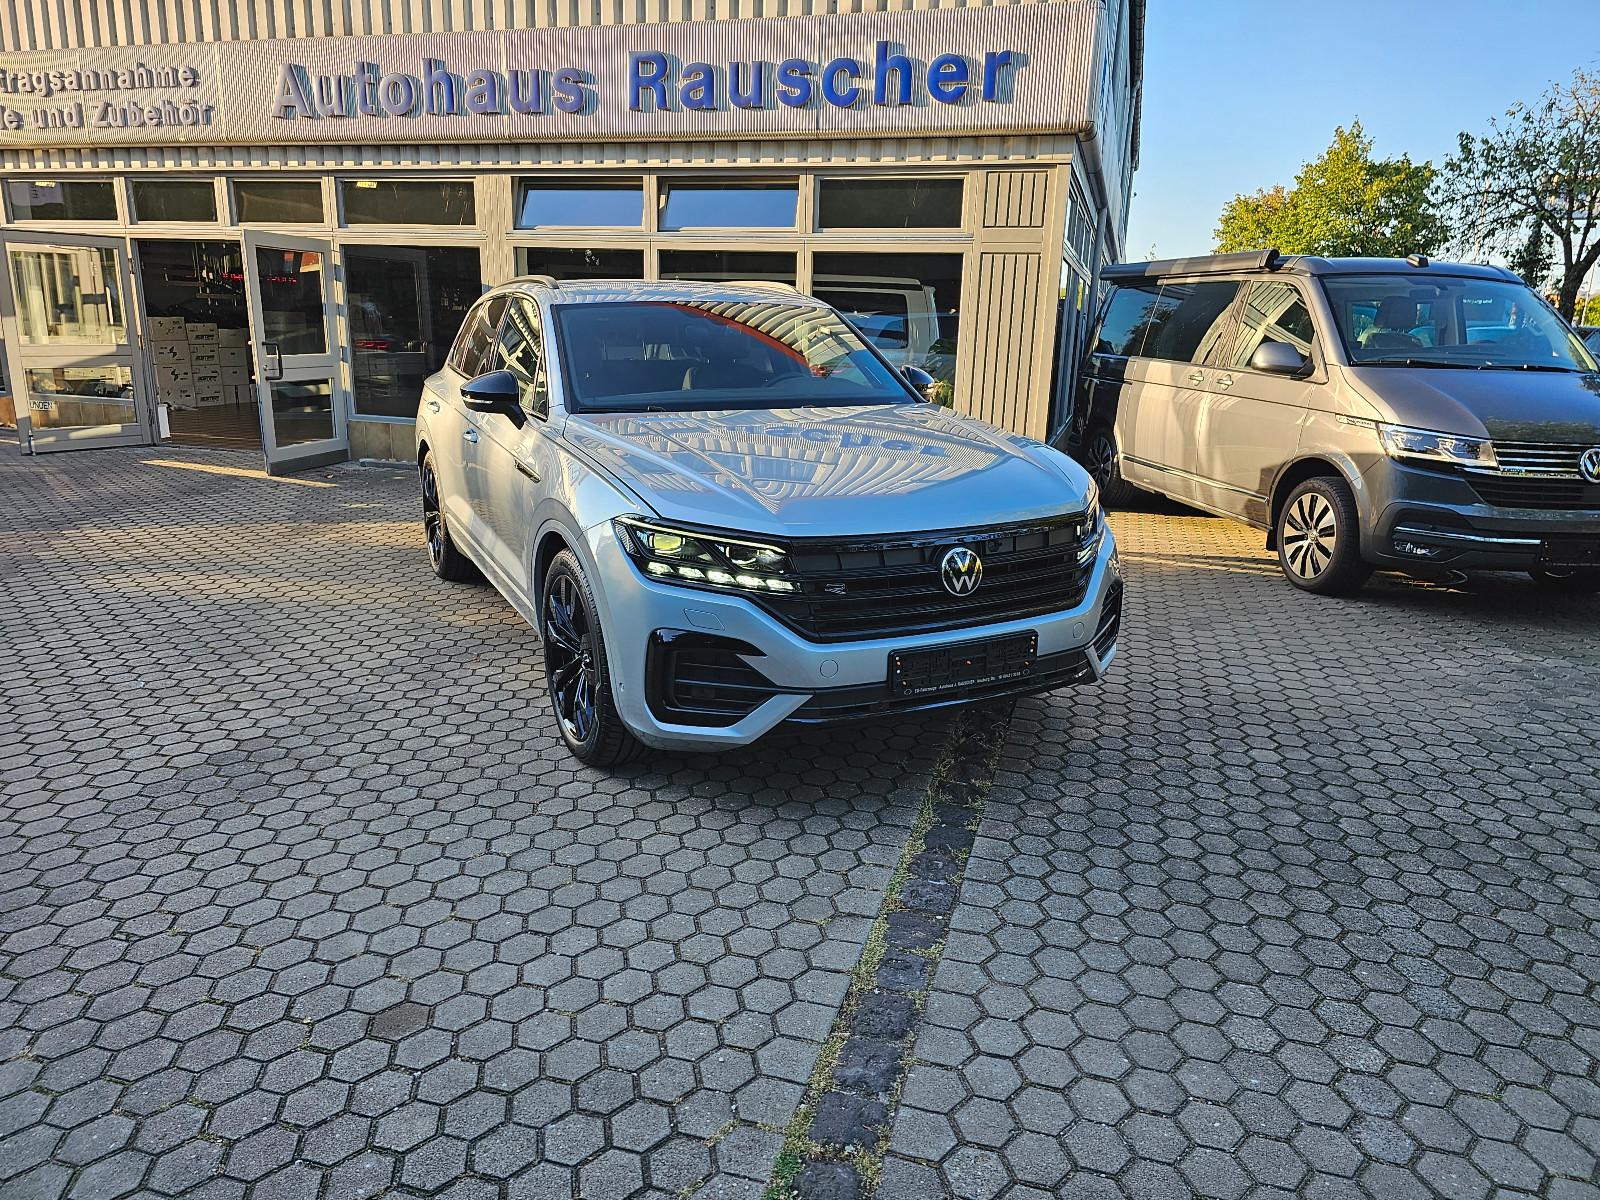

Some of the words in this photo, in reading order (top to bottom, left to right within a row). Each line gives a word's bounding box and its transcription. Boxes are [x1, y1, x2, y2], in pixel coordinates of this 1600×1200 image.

[272, 57, 585, 119] Autohaus
[628, 40, 1012, 111] Rauscher
[0, 105, 19, 129] e
[31, 103, 81, 128] und
[92, 100, 213, 128] Zubehör
